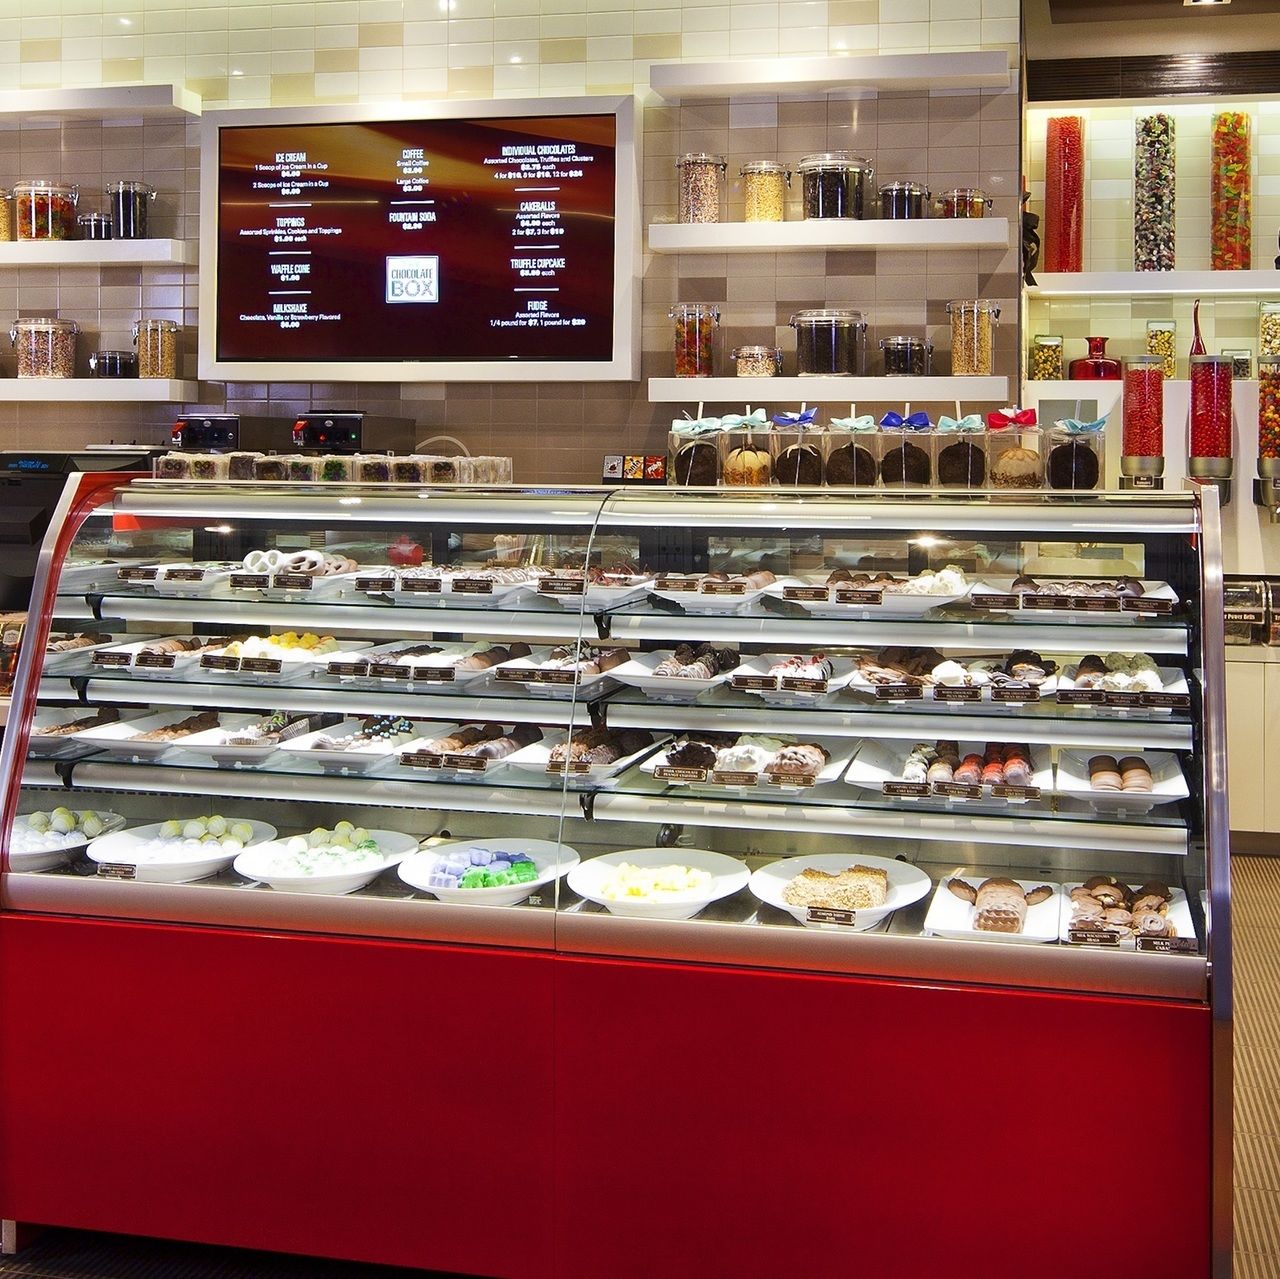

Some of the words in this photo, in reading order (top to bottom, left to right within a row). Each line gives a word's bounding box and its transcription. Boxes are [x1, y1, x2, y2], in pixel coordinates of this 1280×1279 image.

[402, 149, 424, 159] COFFEE
[502, 146, 536, 156] INDIVIDUAL
[537, 144, 576, 155] CHOCOLATES
[276, 153, 284, 163] ICE
[285, 153, 306, 162] CREAM
[520, 201, 555, 212] CAKEBALLS
[276, 217, 305, 227] TOPPINGS
[389, 212, 418, 222] FOUNTAIN
[419, 212, 436, 221] SODA
[510, 259, 536, 269] TRUFFLE
[537, 258, 566, 268] CUPCAKE
[271, 264, 294, 274] WAFFLE
[294, 264, 310, 274] CONE
[391, 268, 432, 279] CHOCOLATE
[391, 280, 433, 297] BOX
[273, 304, 308, 313] MILKSHAKE
[527, 300, 548, 311] FUDGE
